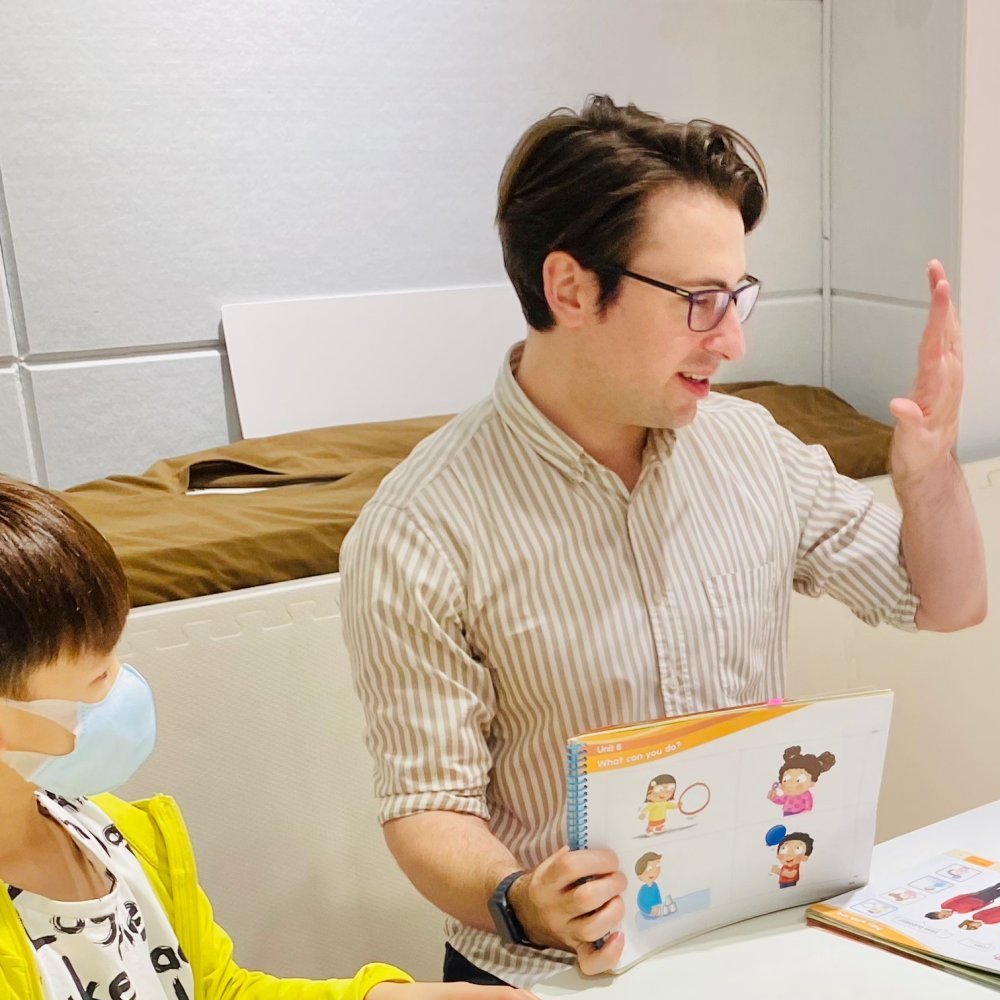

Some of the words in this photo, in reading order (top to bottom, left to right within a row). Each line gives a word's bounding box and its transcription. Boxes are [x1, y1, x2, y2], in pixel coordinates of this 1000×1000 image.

[597, 745, 614, 754] Unit
[597, 758, 623, 768] What
[626, 753, 643, 762] can
[645, 748, 663, 762] you
[665, 741, 682, 753] do?
